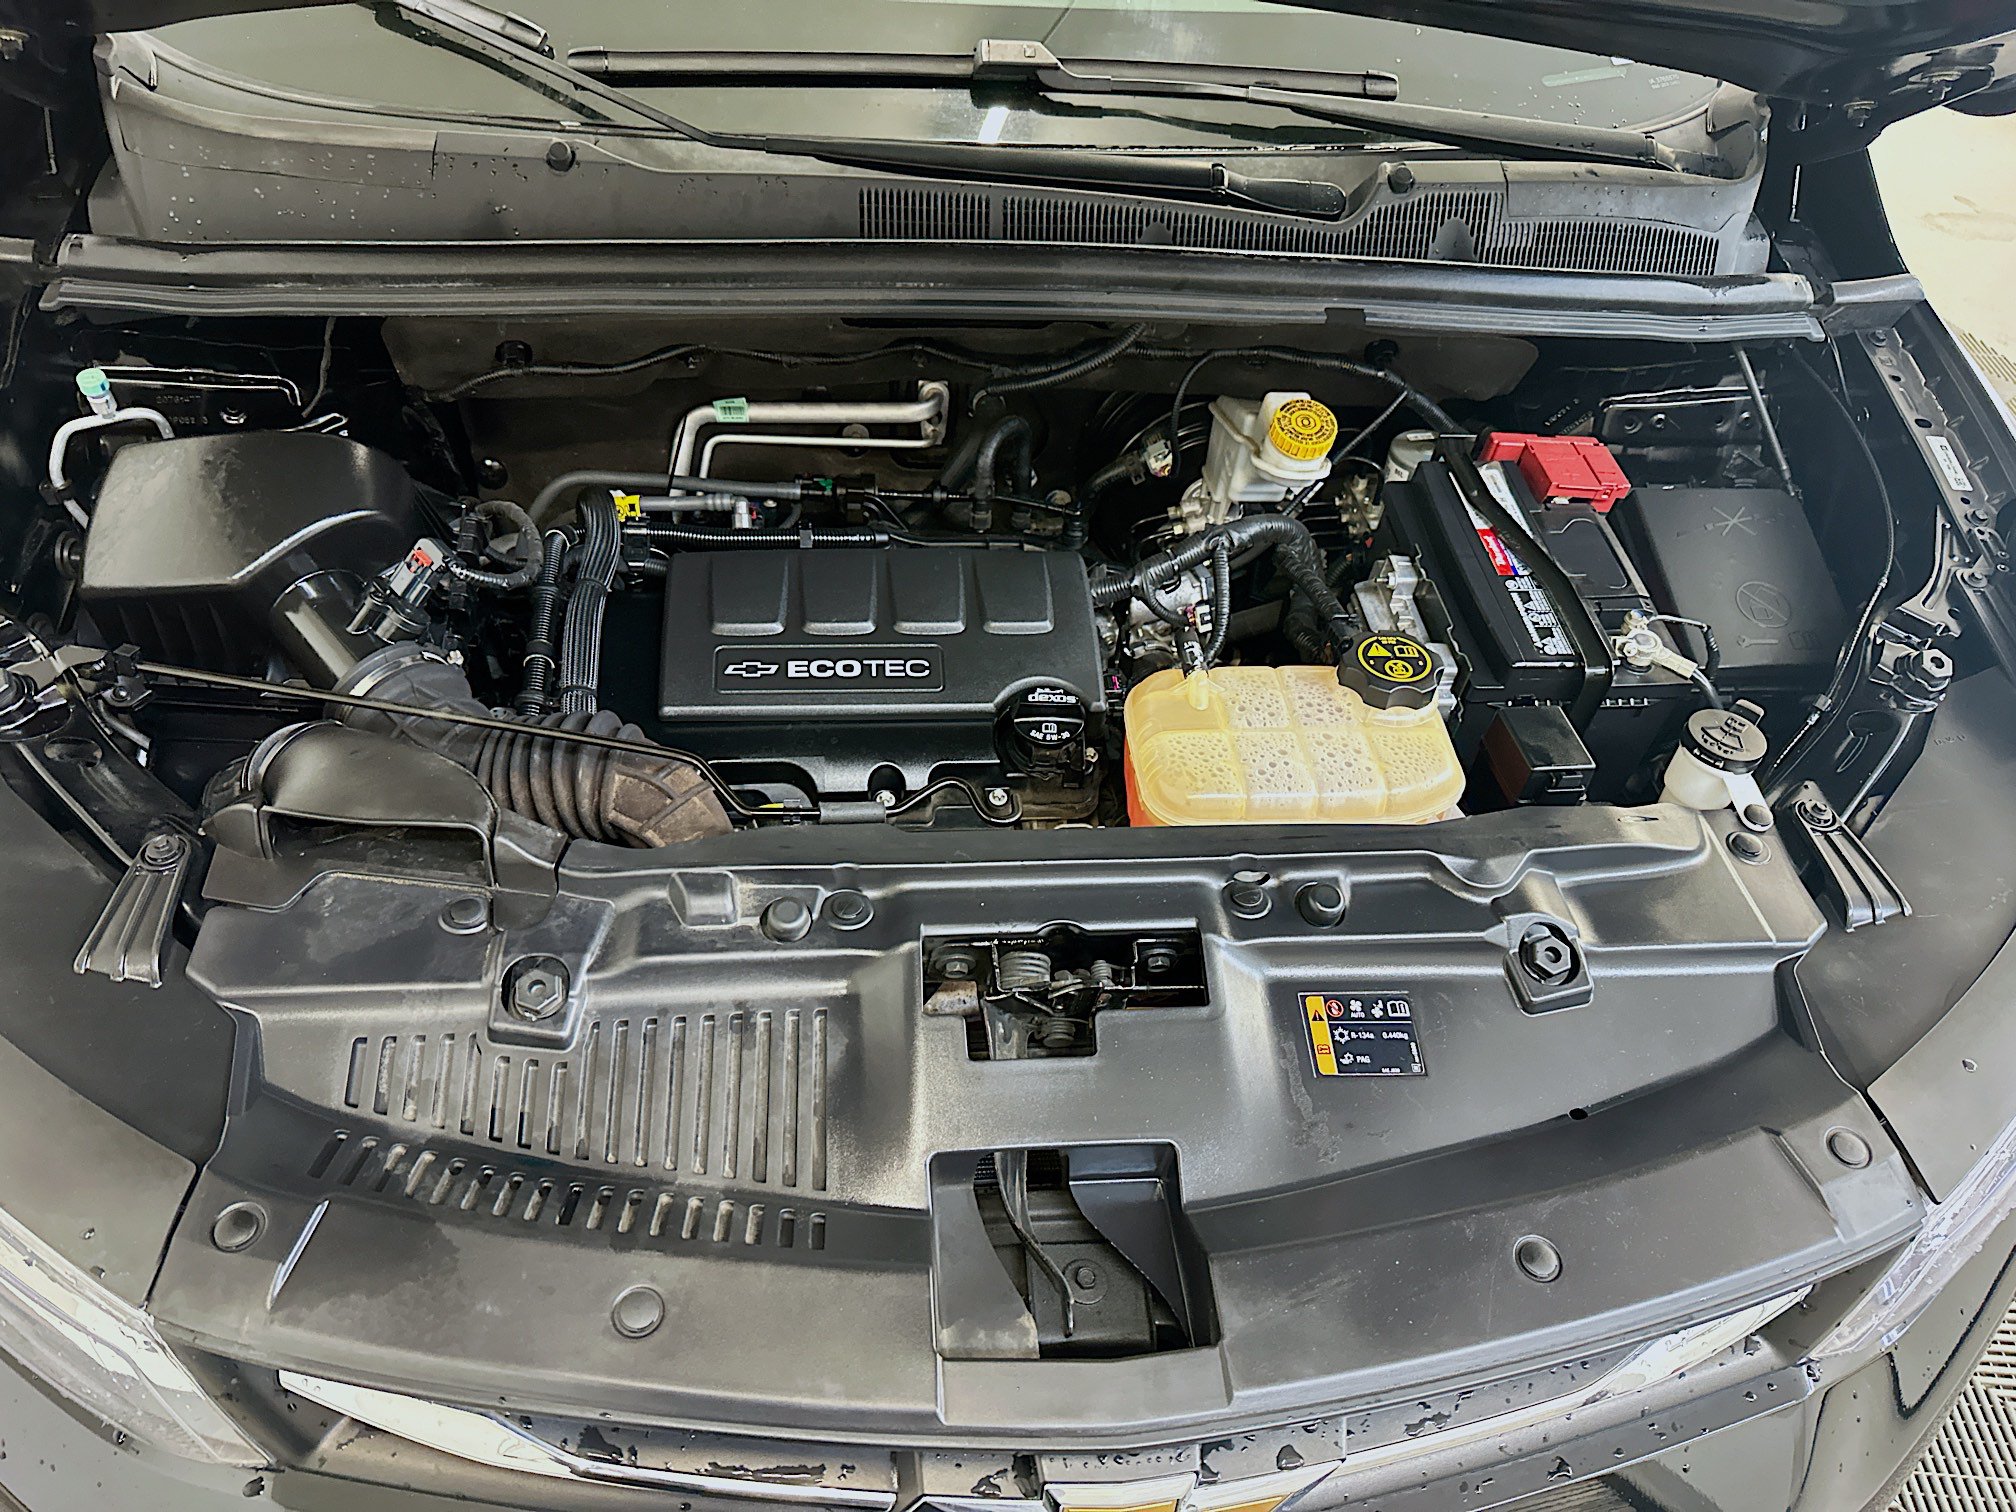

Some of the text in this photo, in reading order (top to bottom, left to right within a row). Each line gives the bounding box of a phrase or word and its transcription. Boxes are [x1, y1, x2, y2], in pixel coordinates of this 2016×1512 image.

[787, 659, 930, 679] ECOTEC
[1027, 692, 1077, 704] dexos
[1029, 729, 1044, 740] SAE
[1382, 1032, 1409, 1040] 0.440kg
